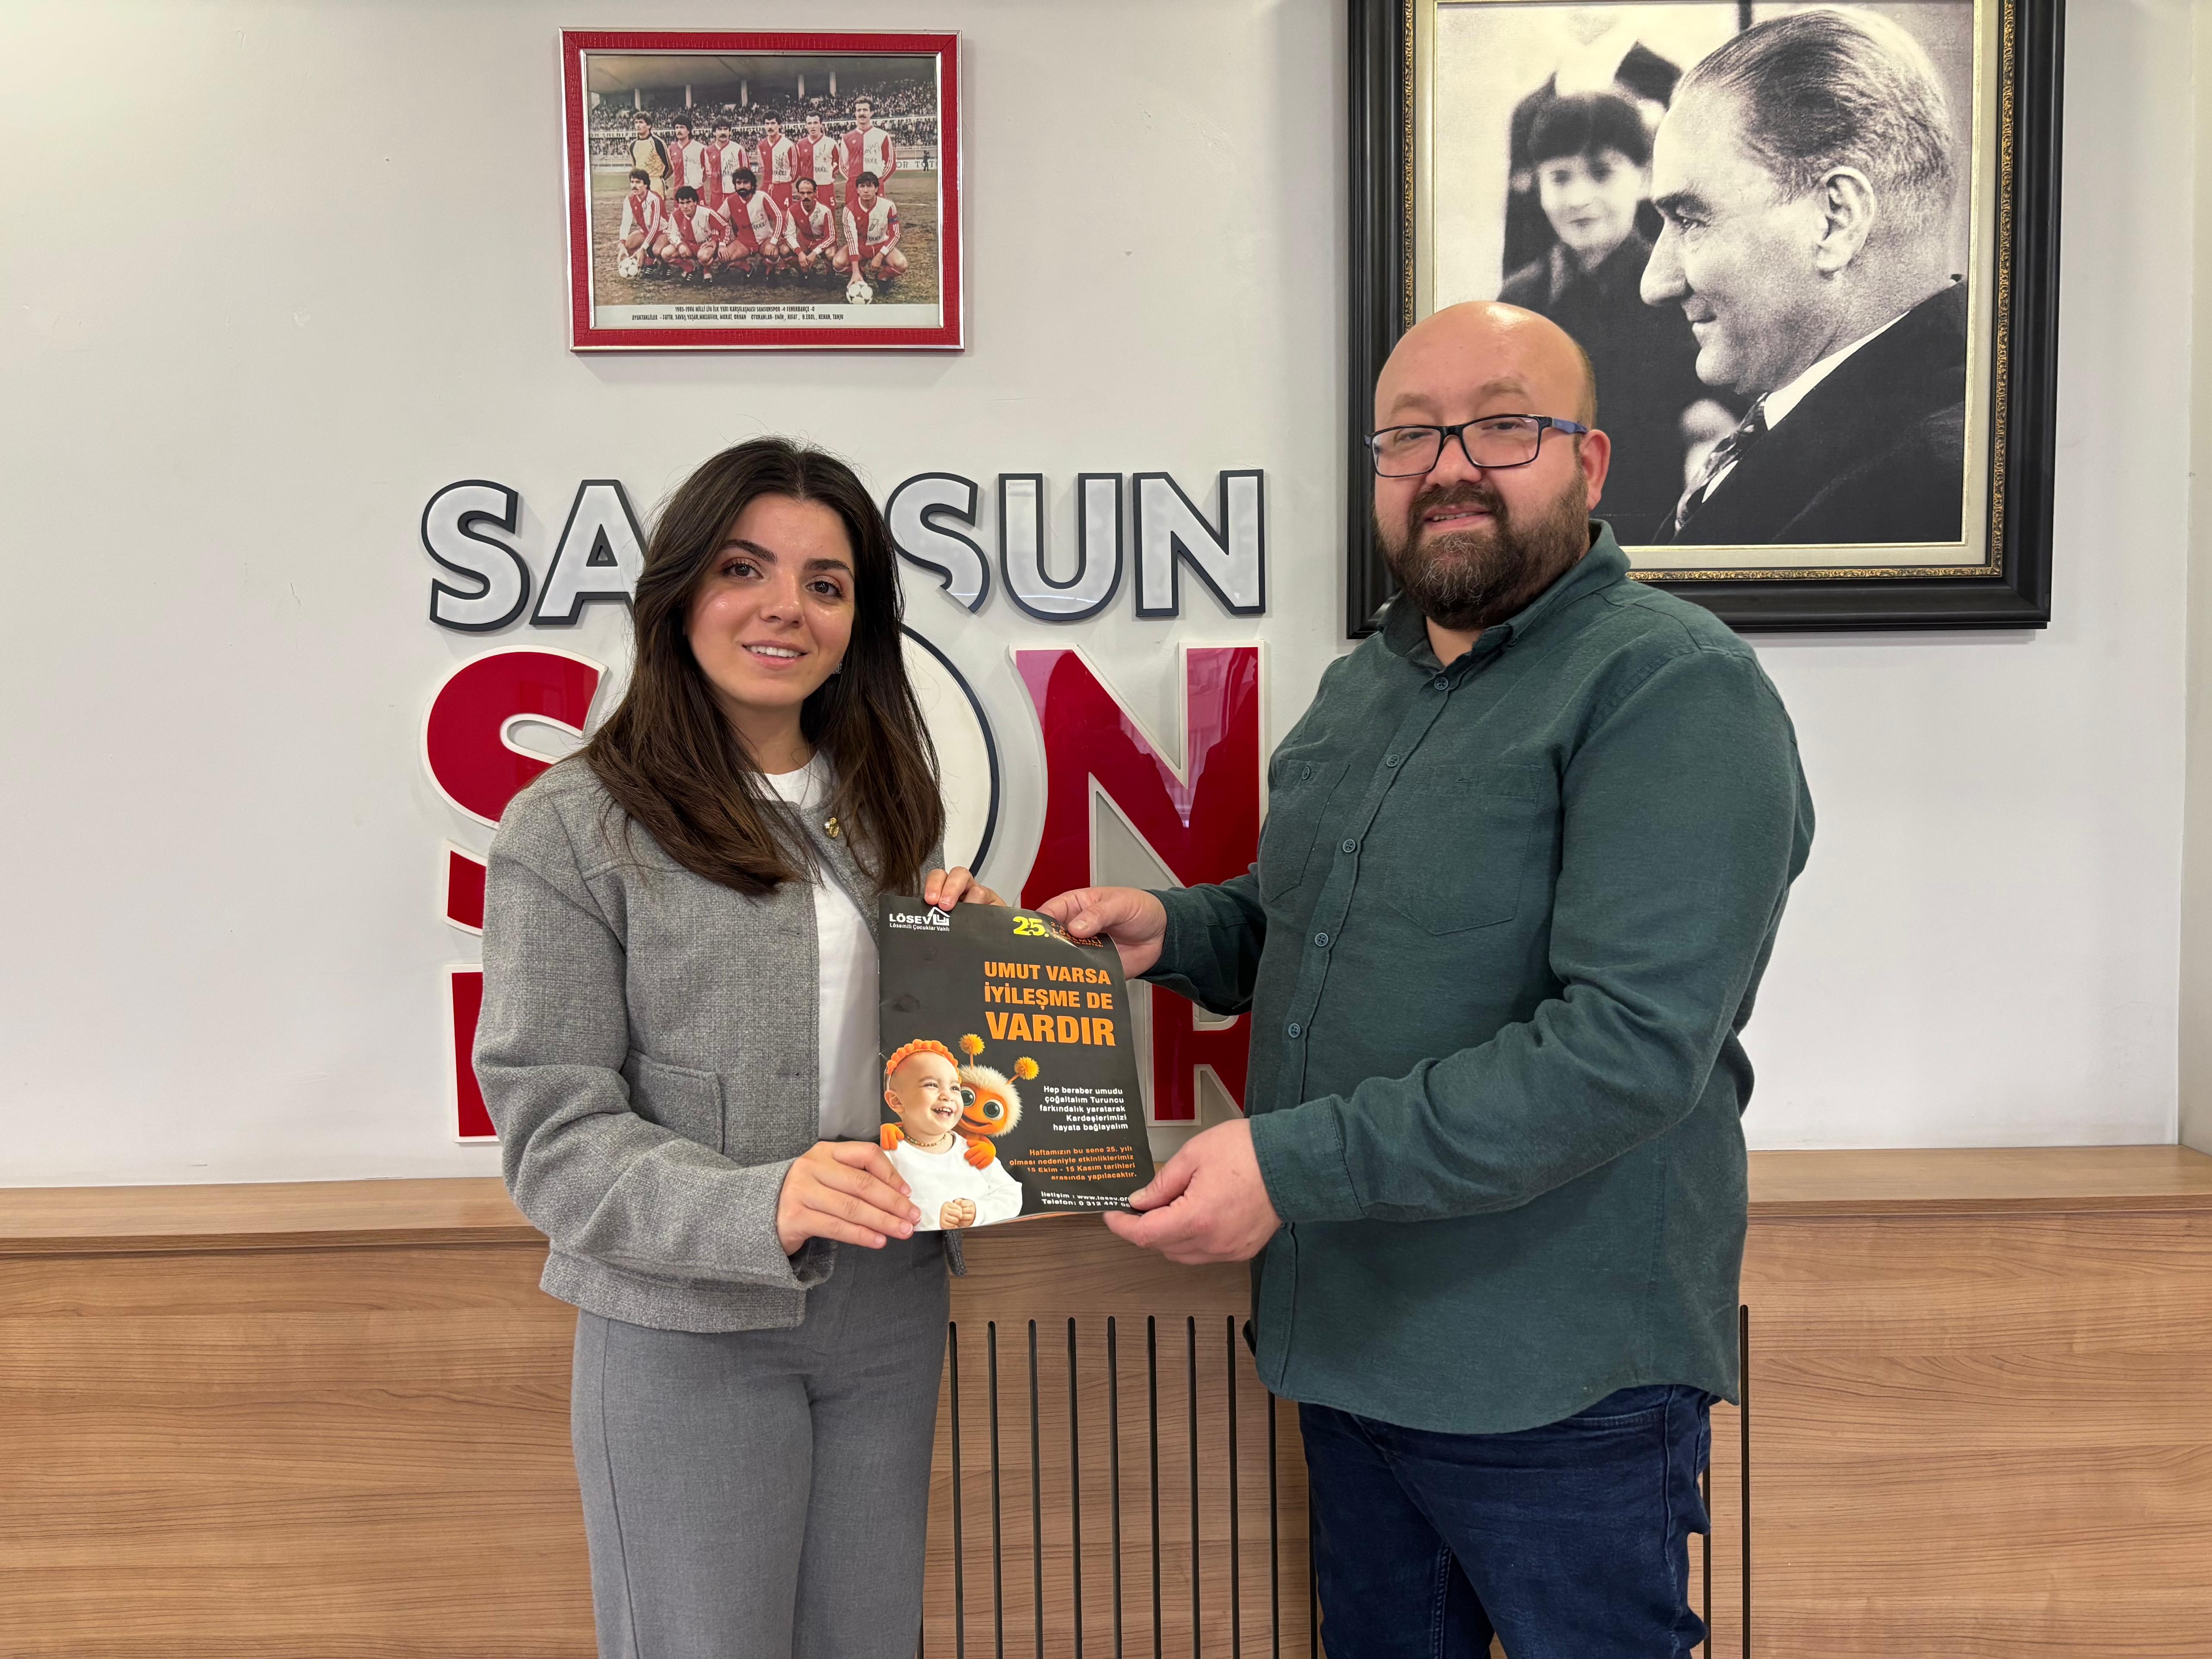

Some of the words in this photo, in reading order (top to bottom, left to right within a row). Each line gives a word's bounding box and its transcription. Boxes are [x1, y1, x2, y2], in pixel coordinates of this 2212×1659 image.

[421, 469, 1266, 632] SASUN
[889, 913, 932, 924] LÖSEV
[1013, 916, 1049, 938] 25.
[984, 961, 1040, 979] UMUT
[1046, 965, 1112, 985] VARSA
[984, 982, 1081, 1010] İYİLEŞME
[1087, 992, 1113, 1010] DE
[985, 1011, 1116, 1046] VARDIR
[1043, 1085, 1059, 1094] Hep
[1045, 1095, 1088, 1104] çoğaltalım
[1039, 1104, 1084, 1112] farkındalık
[1086, 1106, 1126, 1114] yaratarak
[1066, 1114, 1127, 1123] Kardeşlerimizi
[1053, 1123, 1081, 1132] hayata
[1083, 1123, 1128, 1131] bağlayalım
[1078, 1154, 1134, 1163] etkinliklerimiz
[1087, 1171, 1137, 1181] yapılacaktır.
